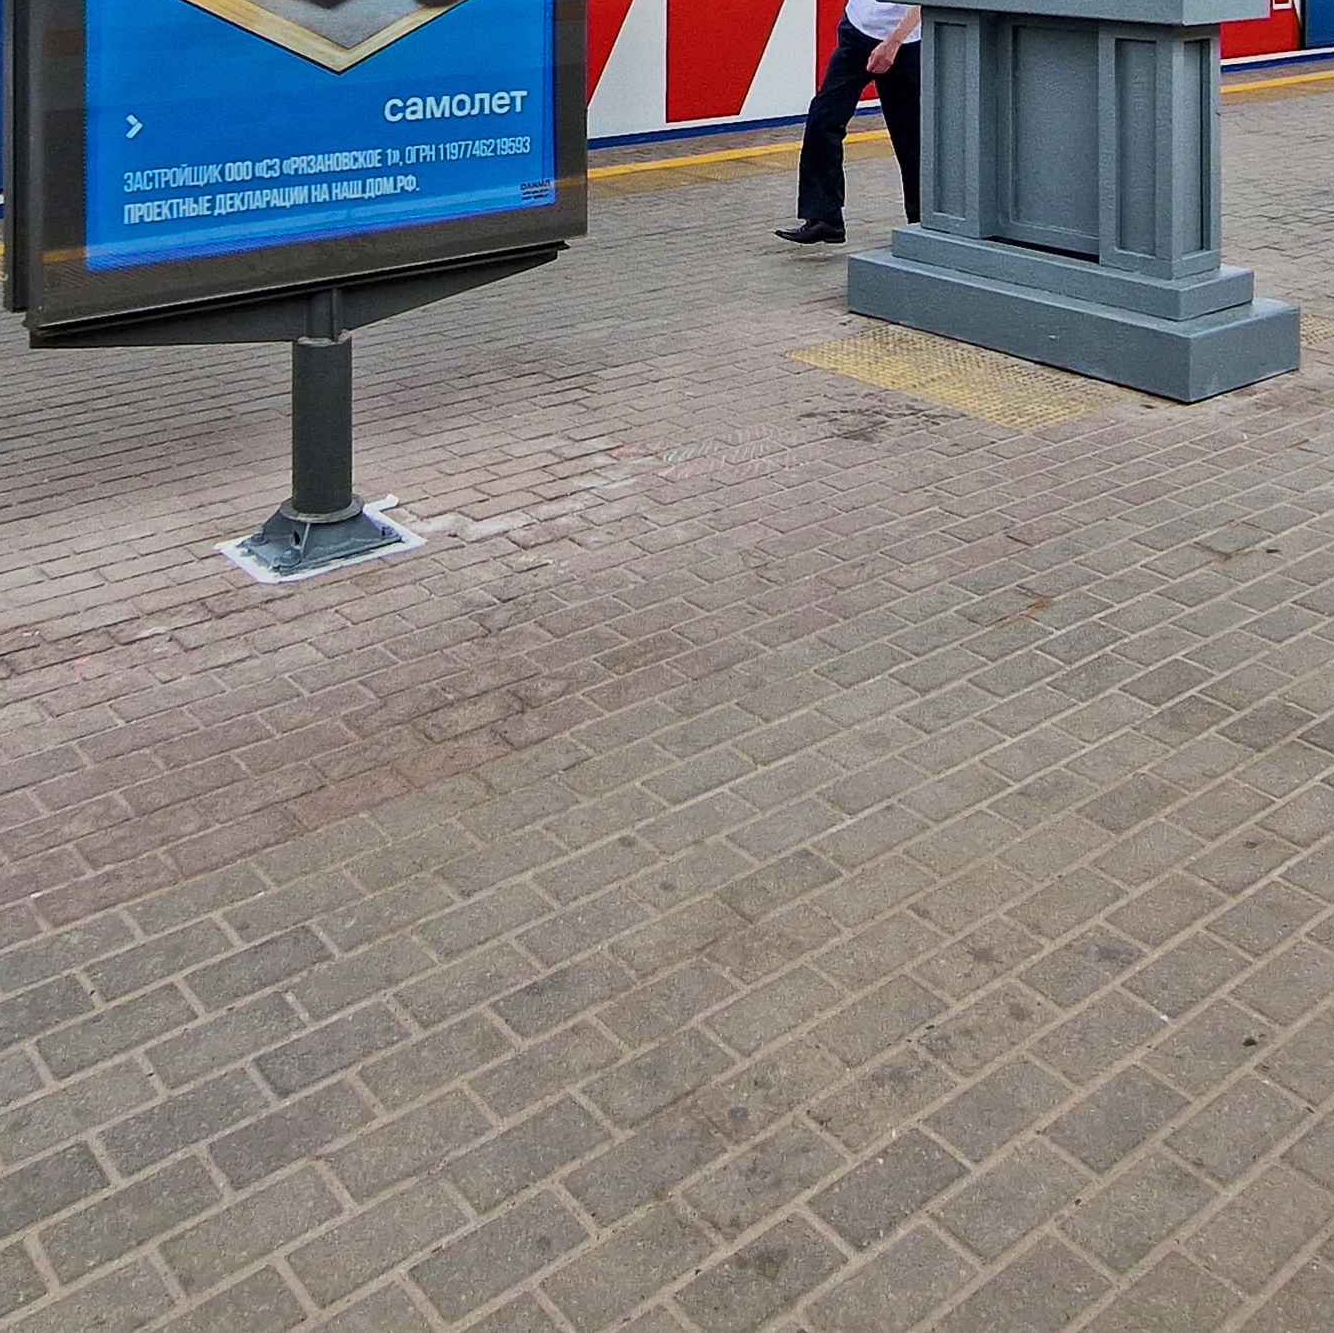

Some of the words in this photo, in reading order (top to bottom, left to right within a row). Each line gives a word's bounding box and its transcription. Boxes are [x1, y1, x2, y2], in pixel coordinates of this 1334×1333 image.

[384, 90, 528, 122] самолет
[123, 163, 222, 193] ЗАСТРОЙЩИК
[225, 160, 253, 182] ООО
[405, 144, 436, 164] ОГРН
[438, 136, 531, 161] 1197746219593
[123, 195, 213, 225] ПРОЕКТНЫЕ
[214, 185, 309, 216] ДЕКЛАРАЦИИ
[311, 183, 330, 202] НА
